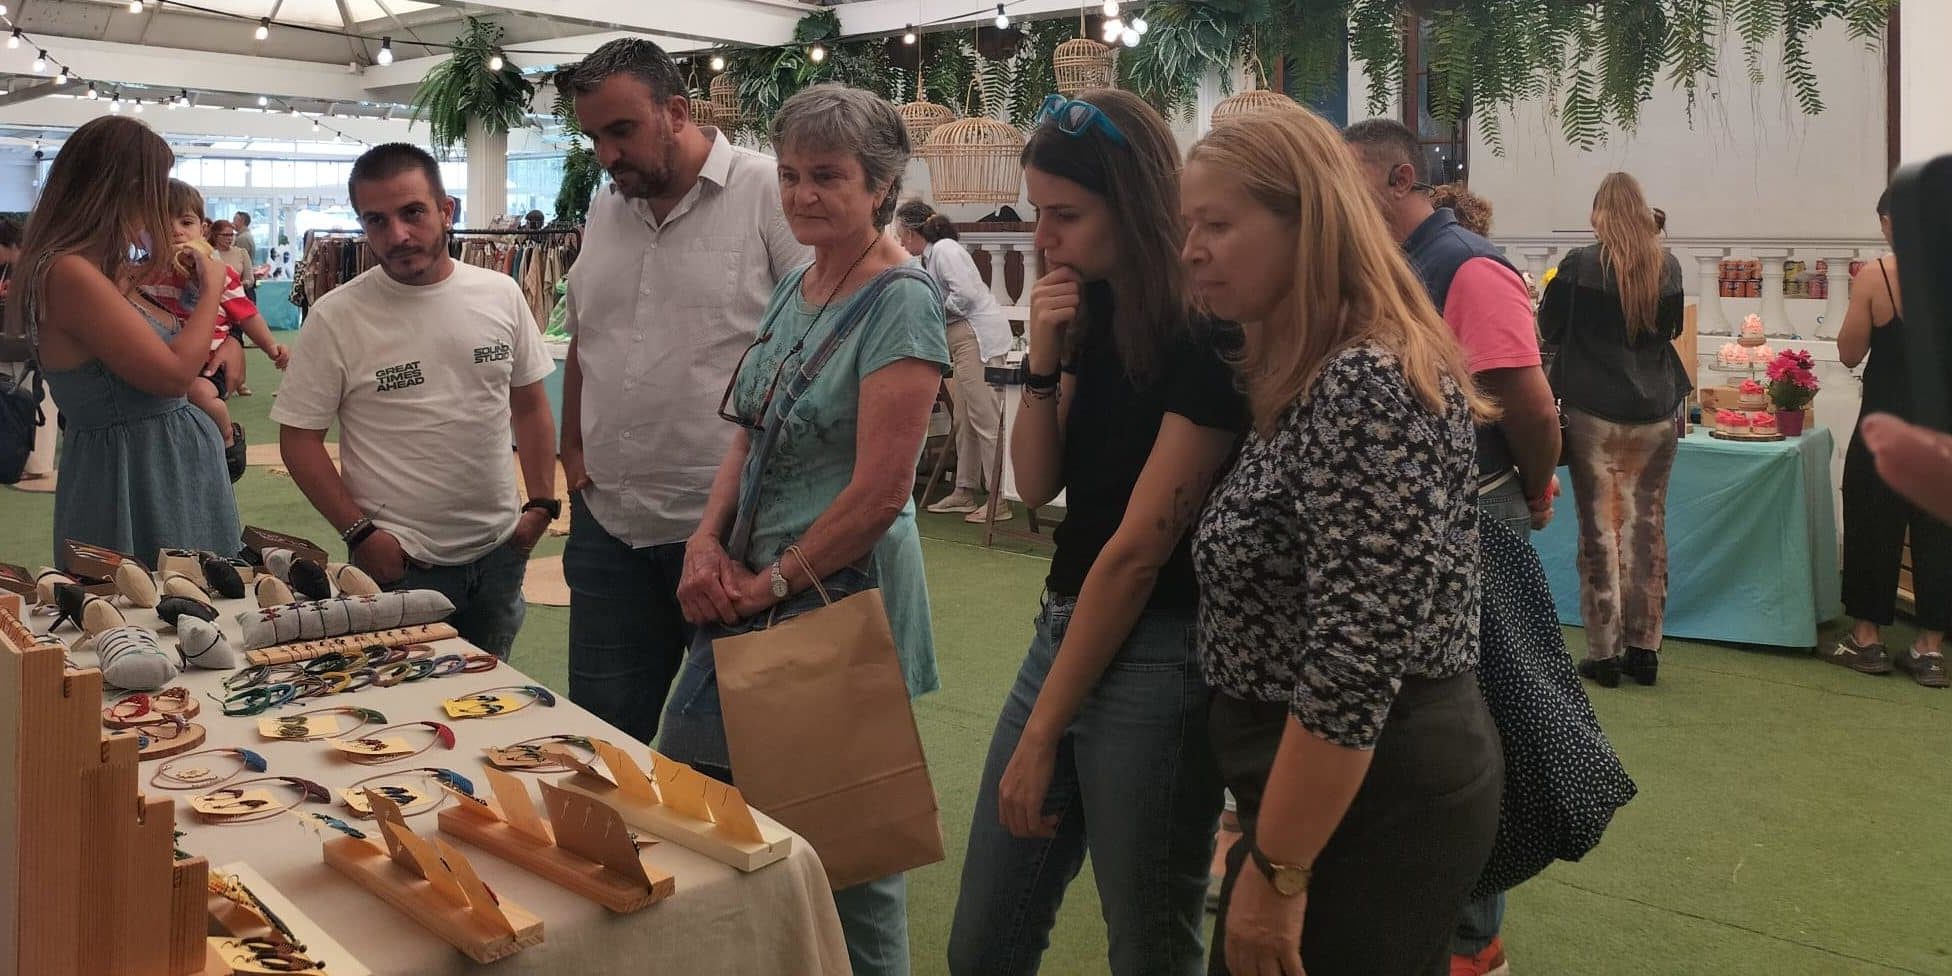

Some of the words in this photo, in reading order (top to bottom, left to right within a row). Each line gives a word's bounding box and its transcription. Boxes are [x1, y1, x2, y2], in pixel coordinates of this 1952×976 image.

[474, 344, 510, 356] SOUND
[376, 361, 420, 377] GREAT
[376, 369, 422, 384] TIMES
[377, 377, 424, 392] AHEAD
